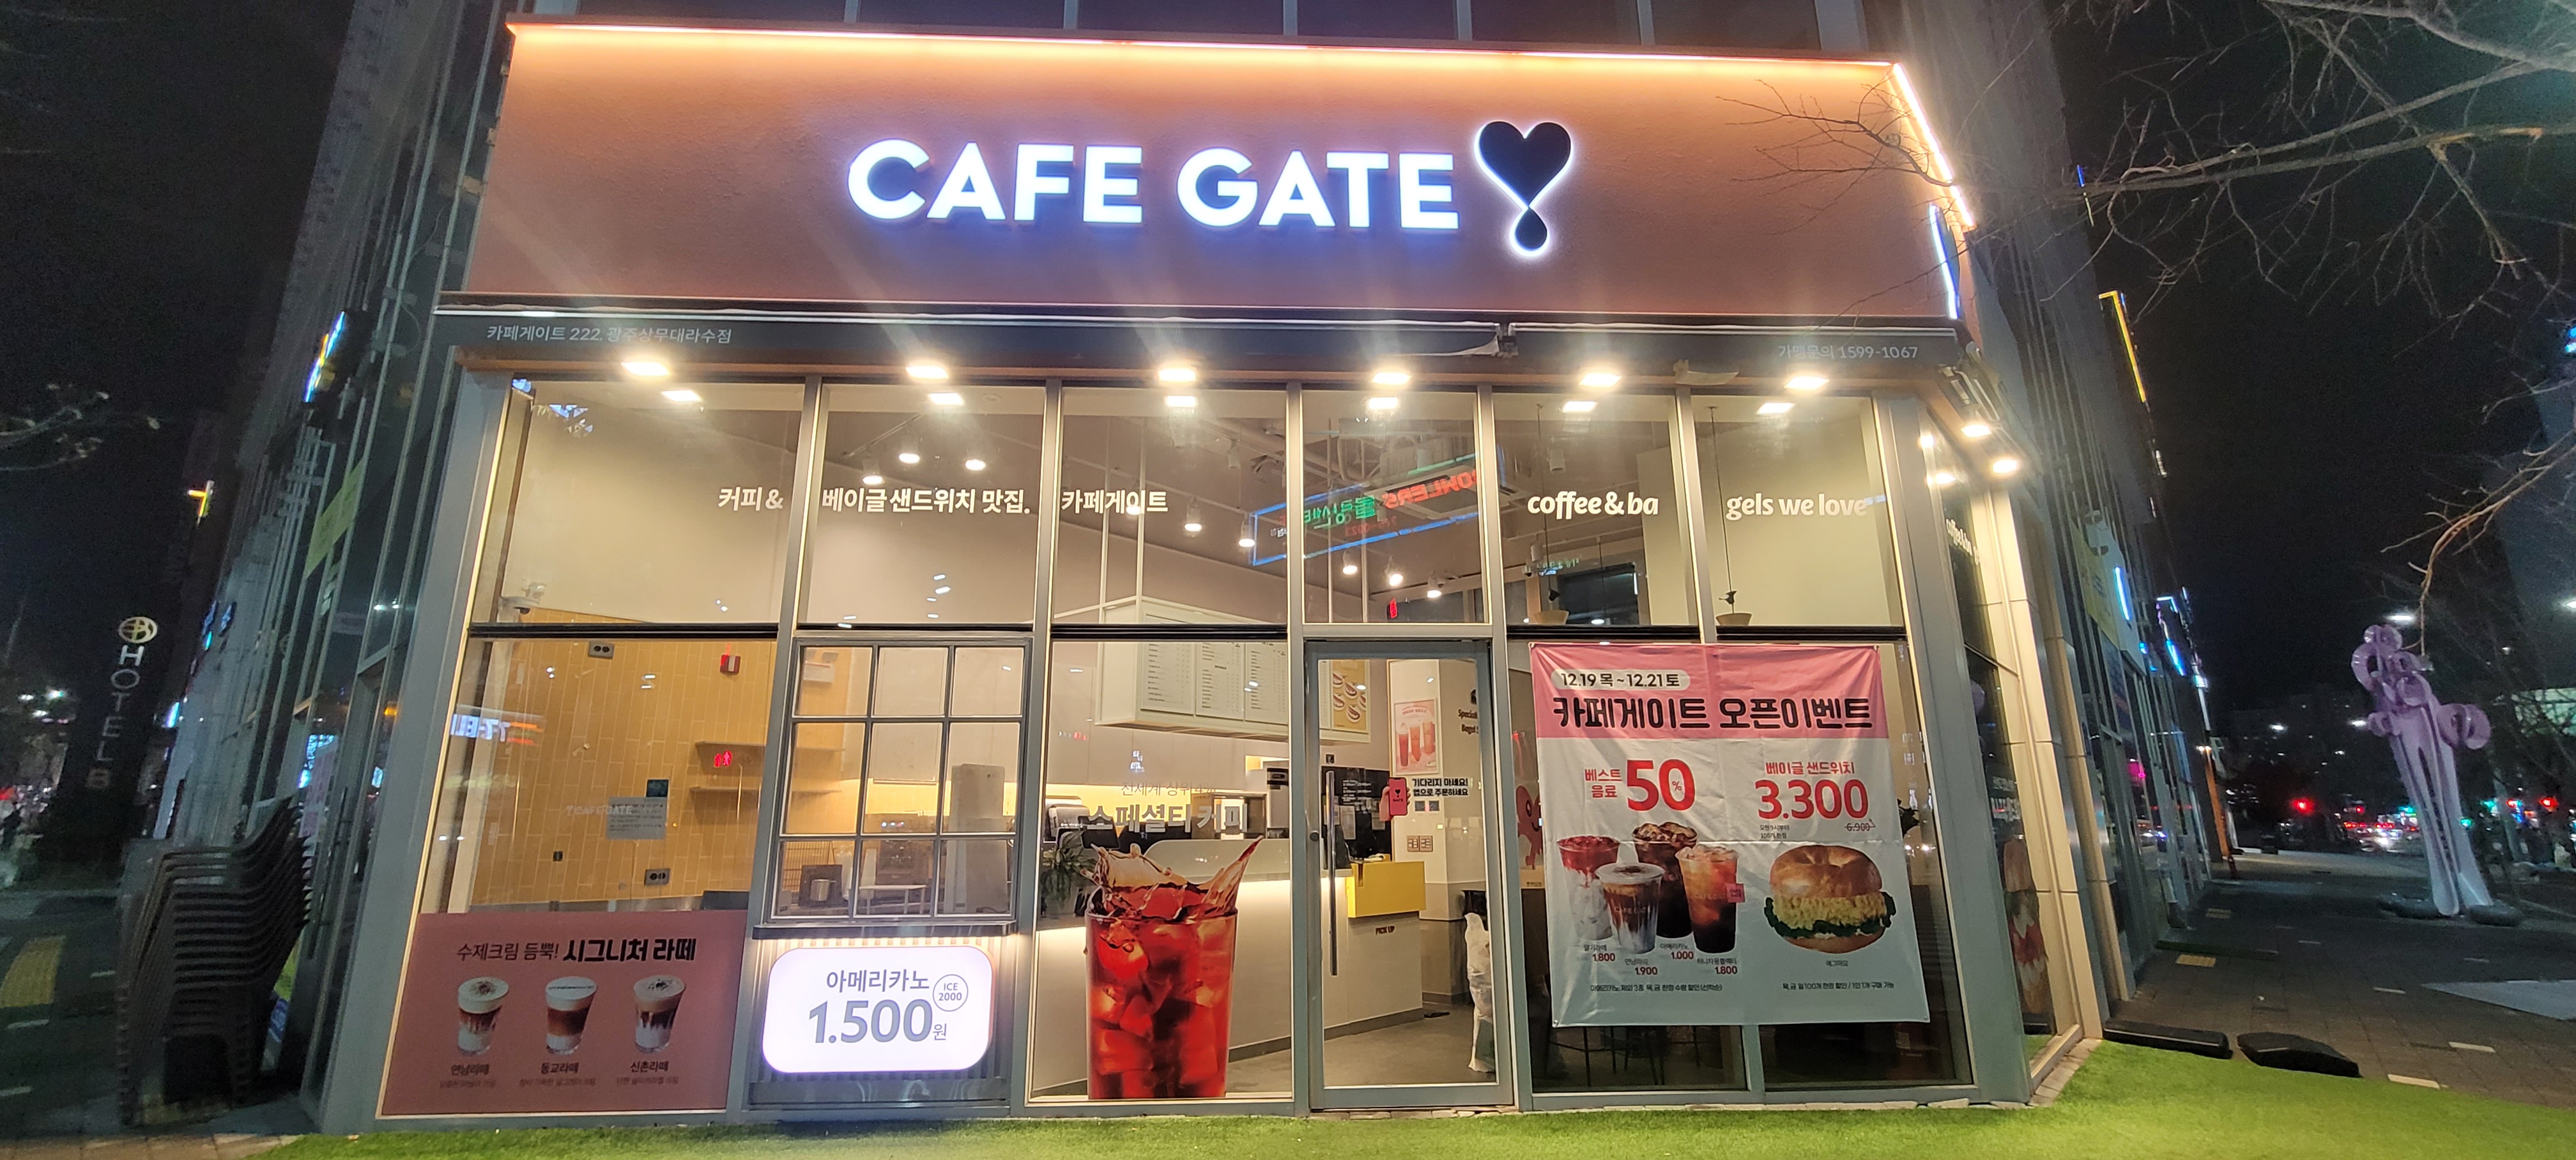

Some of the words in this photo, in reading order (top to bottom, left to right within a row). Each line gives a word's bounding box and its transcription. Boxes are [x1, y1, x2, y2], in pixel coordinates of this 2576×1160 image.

[847, 138, 1144, 224] CAFE
[1177, 146, 1460, 231] GATE
[487, 325, 565, 341] 카페게이트
[569, 328, 602, 341] 222.
[607, 327, 732, 344] 광주상무대라수점
[1779, 345, 1834, 360] 가맹문의
[1839, 346, 1918, 359] 1599-1067
[717, 486, 763, 511] 커피
[822, 487, 887, 512] 베이글
[889, 487, 976, 513] 샌드위치
[982, 489, 1031, 514] 맛집.
[1061, 489, 1169, 514] 카페게이트
[1528, 491, 1602, 520] coffee
[1604, 491, 1625, 515] &
[1627, 492, 1659, 515] ba
[1726, 493, 1773, 521] gels
[1779, 496, 1814, 515] we
[1818, 493, 1867, 516] love
[1561, 673, 1597, 687] 12.19
[1599, 673, 1614, 687] 목
[1666, 674, 1680, 687] 토
[97, 645, 144, 761] HOTEL
[1552, 696, 1710, 729] 카페게이트
[1719, 697, 1873, 729] 오픈이벤트
[1584, 768, 1622, 782] 베스트
[1765, 761, 1804, 775] 베이글
[1806, 761, 1855, 775] 샌드위치
[1121, 782, 1161, 797] 전세계
[1166, 781, 1192, 797] 상위
[1412, 778, 1442, 786] 기다리지
[1444, 778, 1468, 786] 마세요!
[1435, 788, 1468, 797] 주문하세요
[1591, 785, 1618, 798] 음료
[1754, 779, 1869, 820] 3.300
[1087, 804, 1192, 834] 스페셜티
[1197, 803, 1248, 834] 커피
[1846, 823, 1871, 832] 6.900
[456, 943, 519, 961] 수제크림
[563, 938, 648, 962] 시그니처
[653, 938, 696, 961] 라떼
[1592, 953, 1616, 962] 1.800
[1671, 951, 1694, 959] 1.000
[1634, 966, 1658, 975] 1.900
[1714, 966, 1738, 975] 1.800
[826, 969, 930, 993] 아메리카노
[944, 982, 958, 991] ICE
[939, 992, 962, 1001] 2000
[631, 1061, 668, 1073] 신촌라떼
